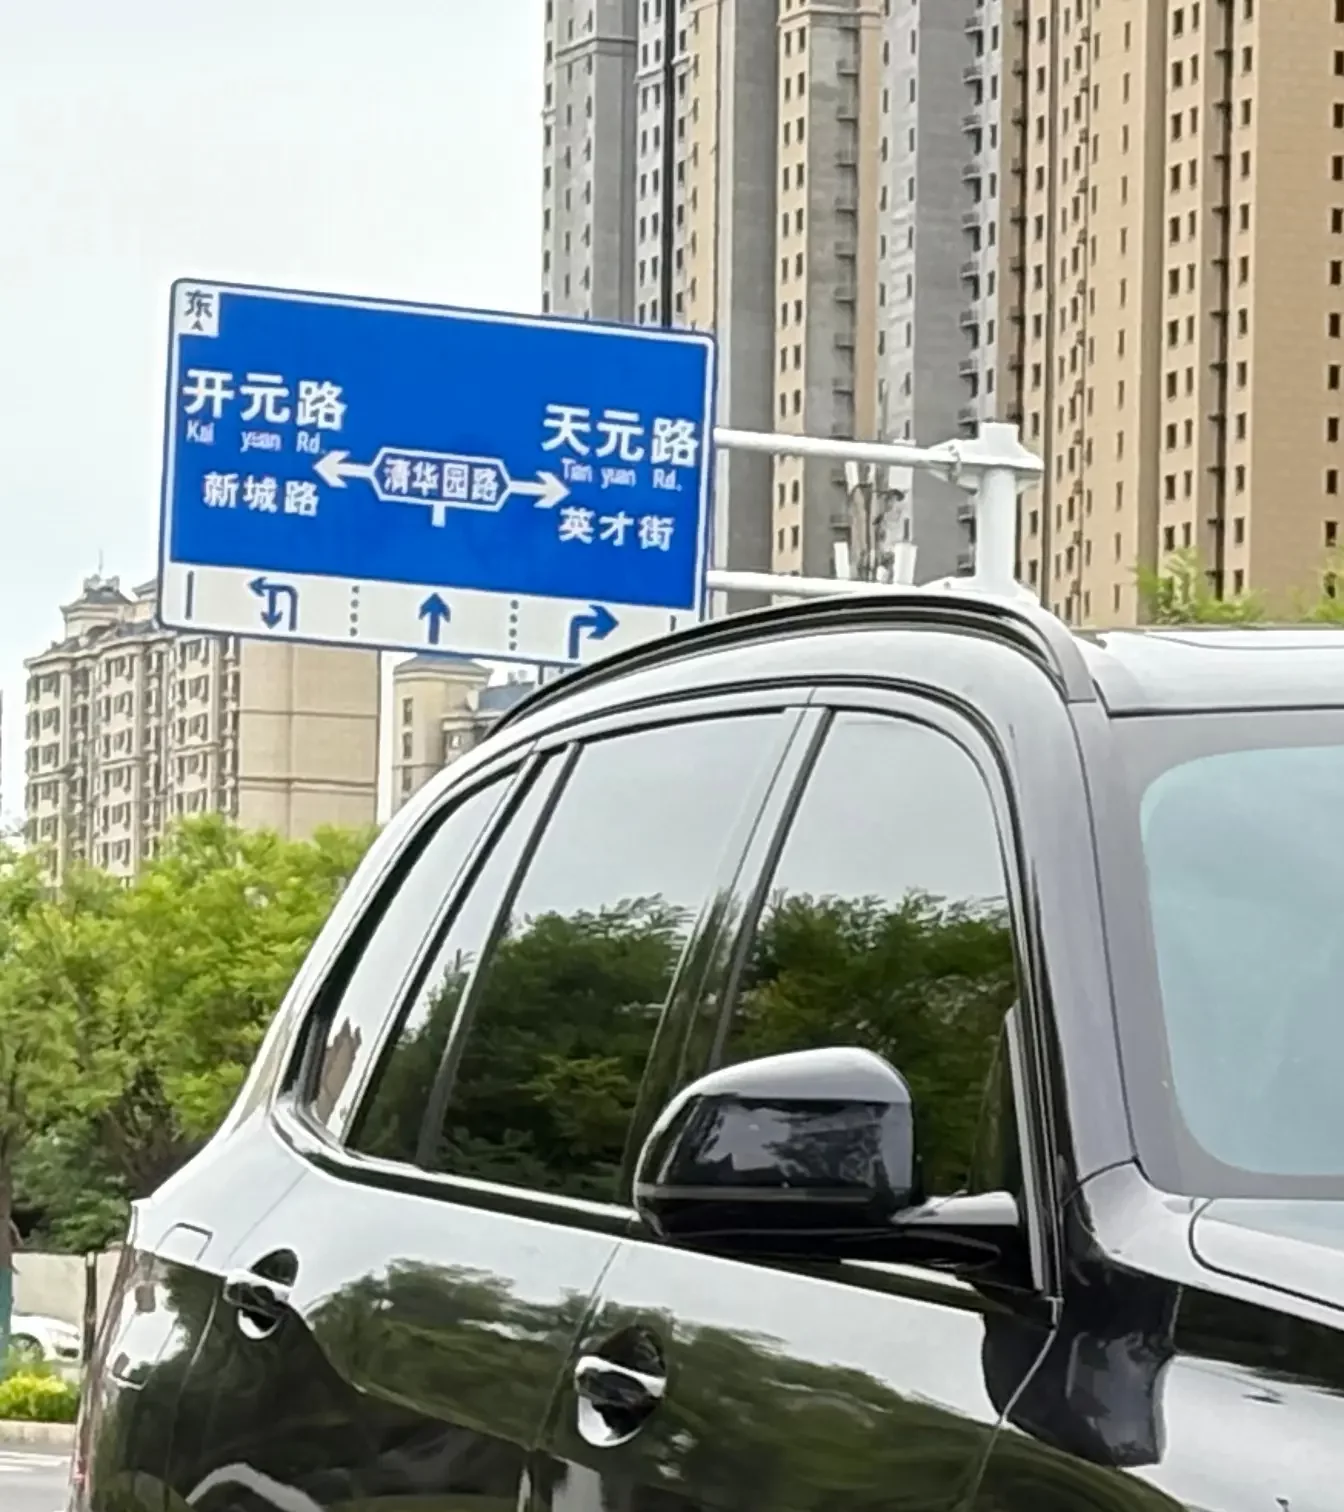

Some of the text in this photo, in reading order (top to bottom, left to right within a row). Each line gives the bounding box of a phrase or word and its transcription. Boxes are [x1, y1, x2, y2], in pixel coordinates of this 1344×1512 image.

[184, 289, 214, 318] 东
[182, 368, 348, 432] 开元路
[186, 419, 215, 445] Kai
[240, 430, 282, 453] yuan
[541, 403, 699, 468] 天元路
[203, 471, 320, 517] 新城路
[383, 457, 499, 502] 清华园路
[601, 467, 637, 489] yuan
[652, 468, 683, 492] Rd.
[558, 506, 675, 551] 英才街
